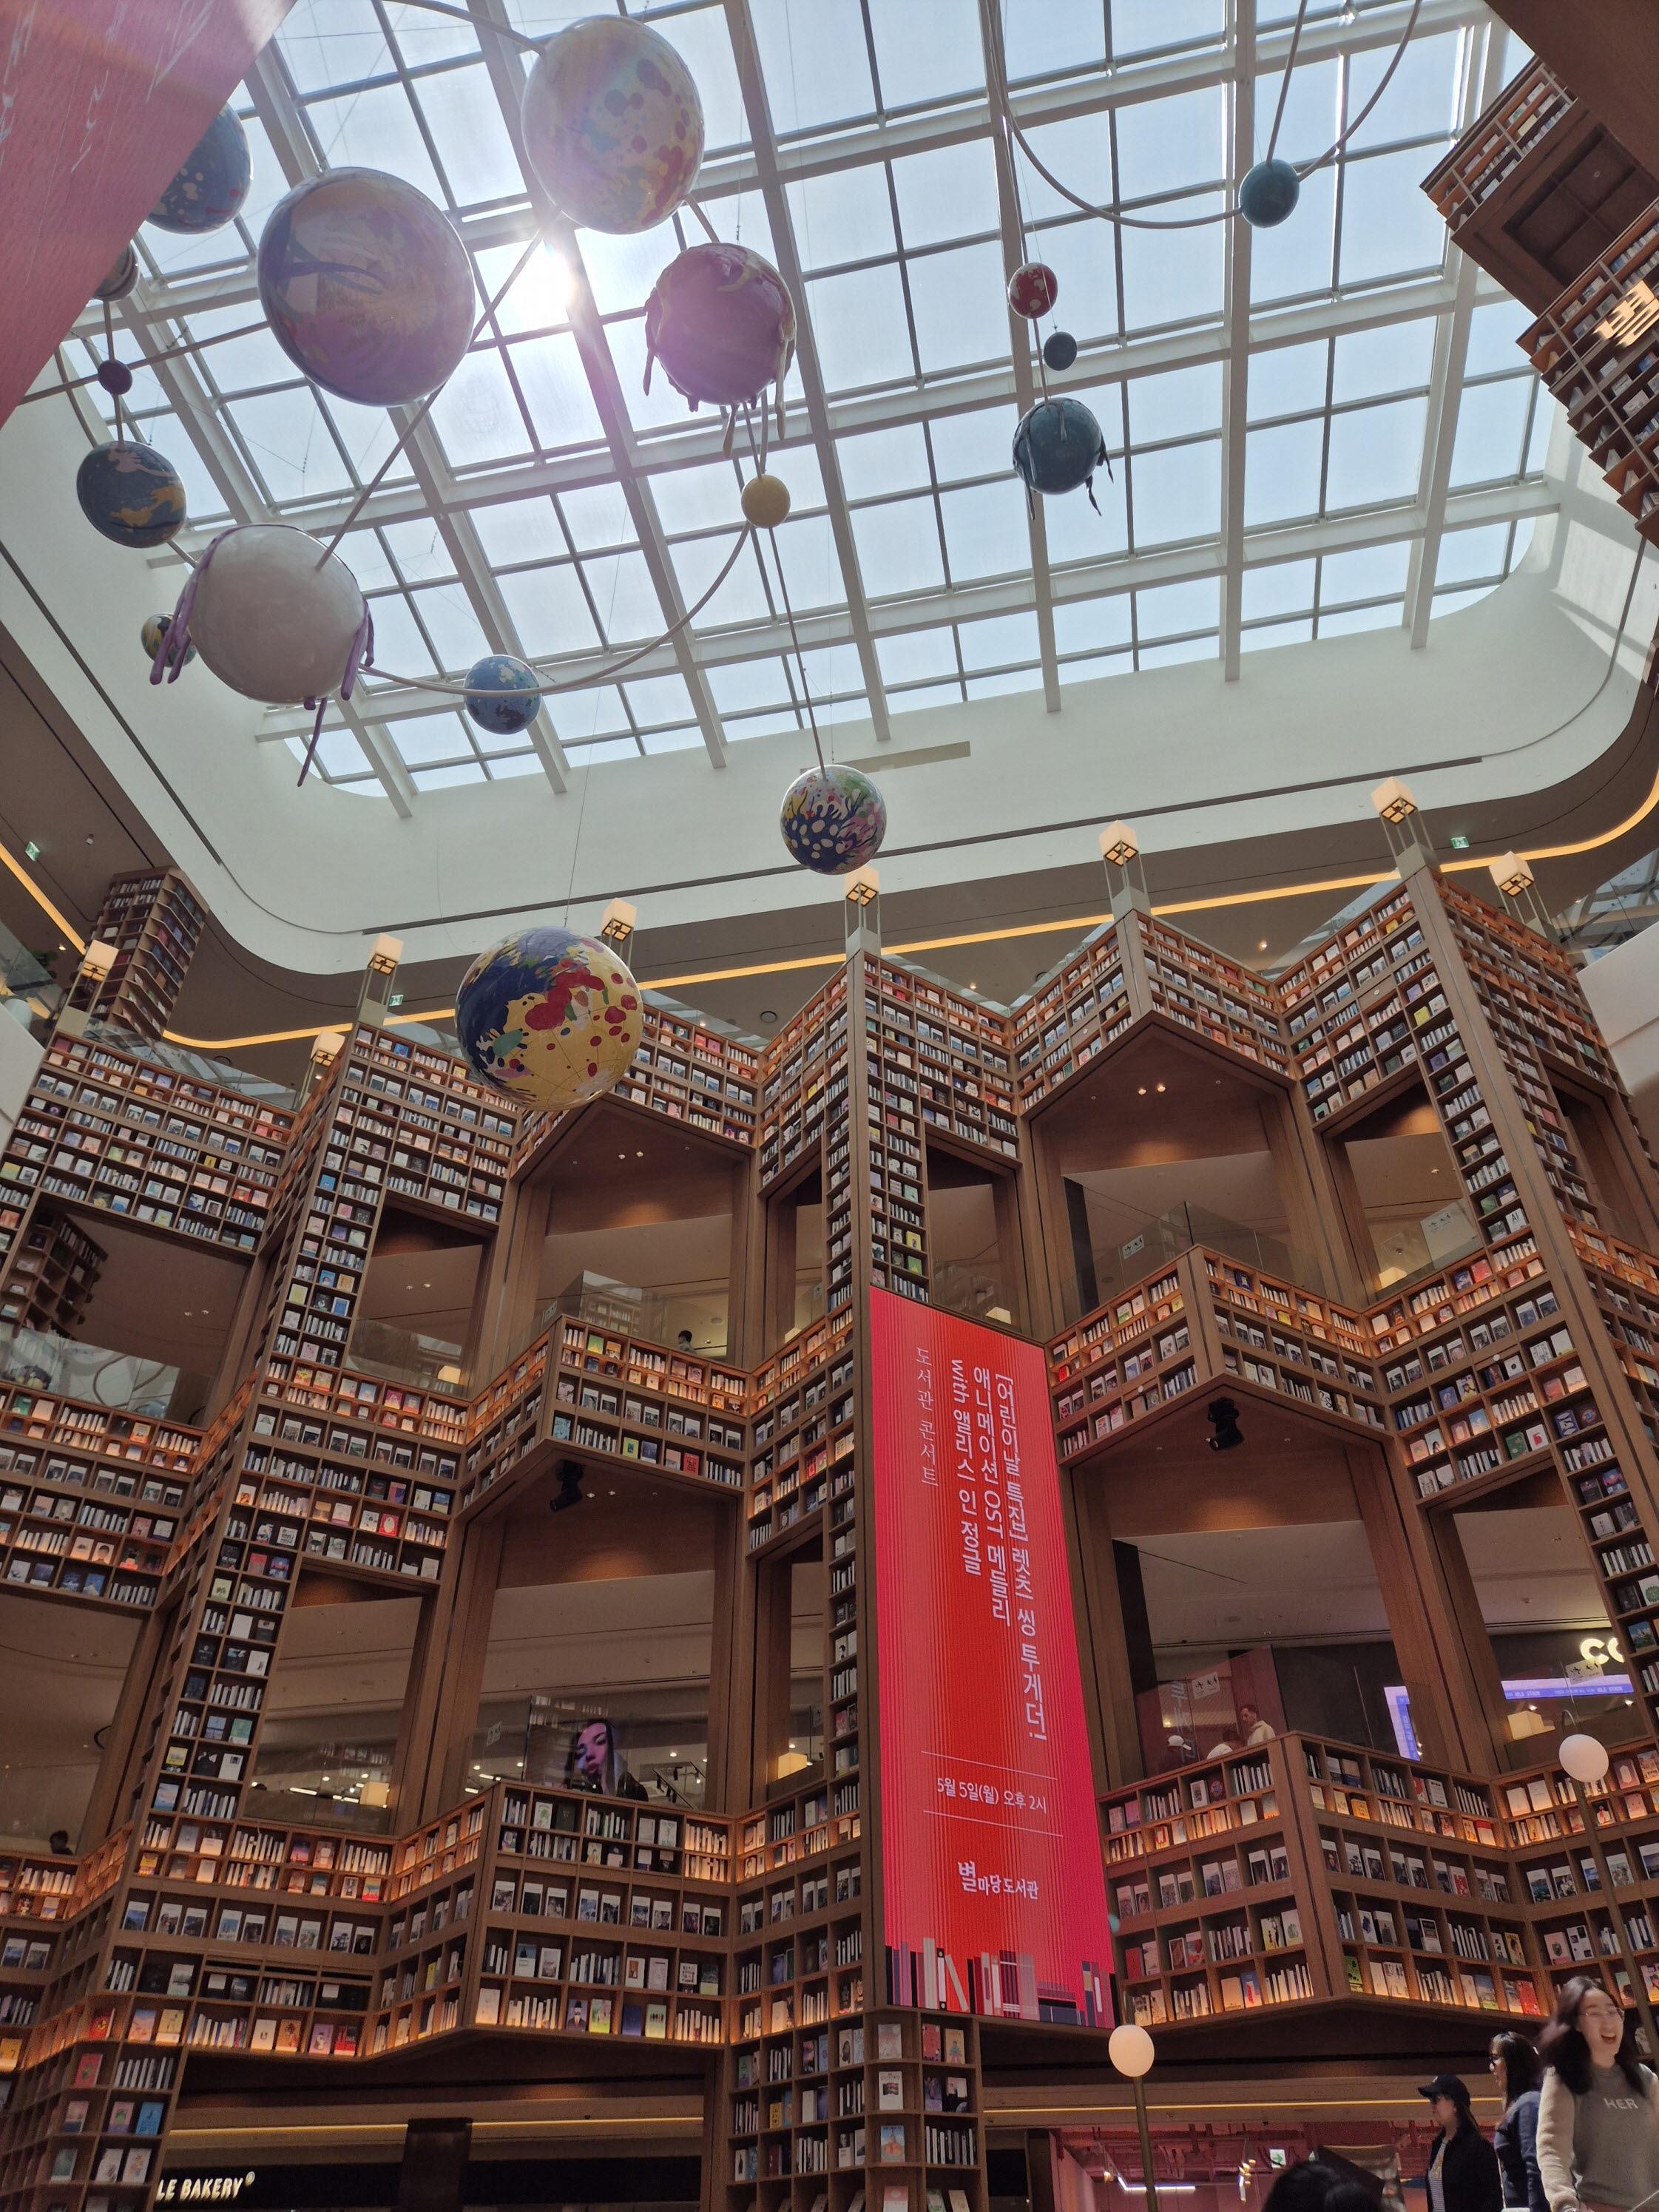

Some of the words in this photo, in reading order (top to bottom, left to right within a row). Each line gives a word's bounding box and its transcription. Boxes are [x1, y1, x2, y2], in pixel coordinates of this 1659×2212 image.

[916, 1347, 934, 1411] 도서관
[951, 1359, 970, 1404] with
[919, 1419, 939, 1486] 콘서트
[953, 1409, 976, 1482] 앨리스
[973, 1367, 999, 1485] 애니메이션
[996, 1373, 1021, 1477] [어린이날
[959, 1489, 978, 1516] 인
[984, 1489, 1004, 1540] OST
[1007, 1481, 1029, 1542] 특집]
[961, 1520, 982, 1576] 정글
[1011, 1547, 1034, 1600] 렛츠
[987, 1545, 1010, 1628] 메들리
[1017, 1608, 1036, 1637] 씽
[1021, 1643, 1047, 1741] 투게더!
[937, 1777, 956, 1798] 5월
[959, 1781, 999, 1805] 5일(월)
[1003, 1790, 1027, 1810] 오후
[1028, 1795, 1047, 1815] 2시
[1603, 2097, 1638, 2109] HER
[179, 2177, 243, 2201] BAKERY
